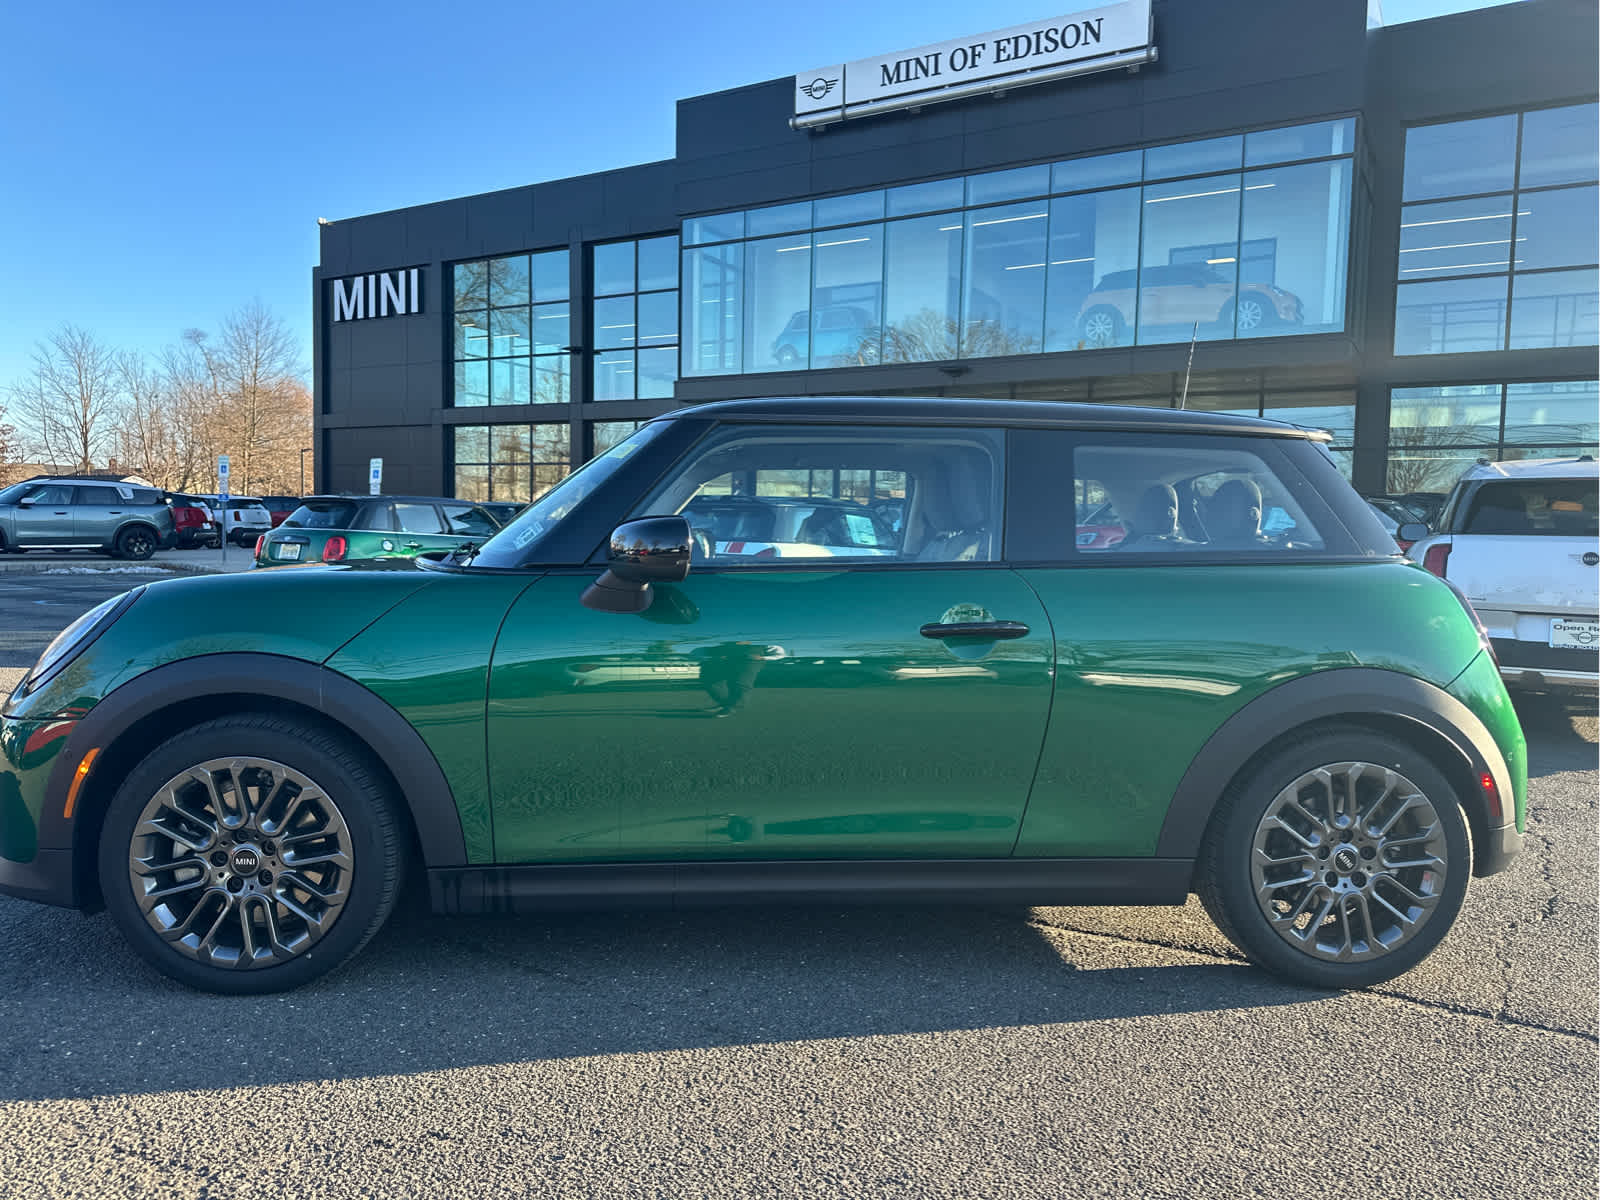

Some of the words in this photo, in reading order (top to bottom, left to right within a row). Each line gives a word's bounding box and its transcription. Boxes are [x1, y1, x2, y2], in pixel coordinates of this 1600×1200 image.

[880, 52, 942, 87] MINI
[950, 43, 986, 72] OF
[993, 18, 1104, 64] EDISON
[333, 268, 418, 322] MINI
